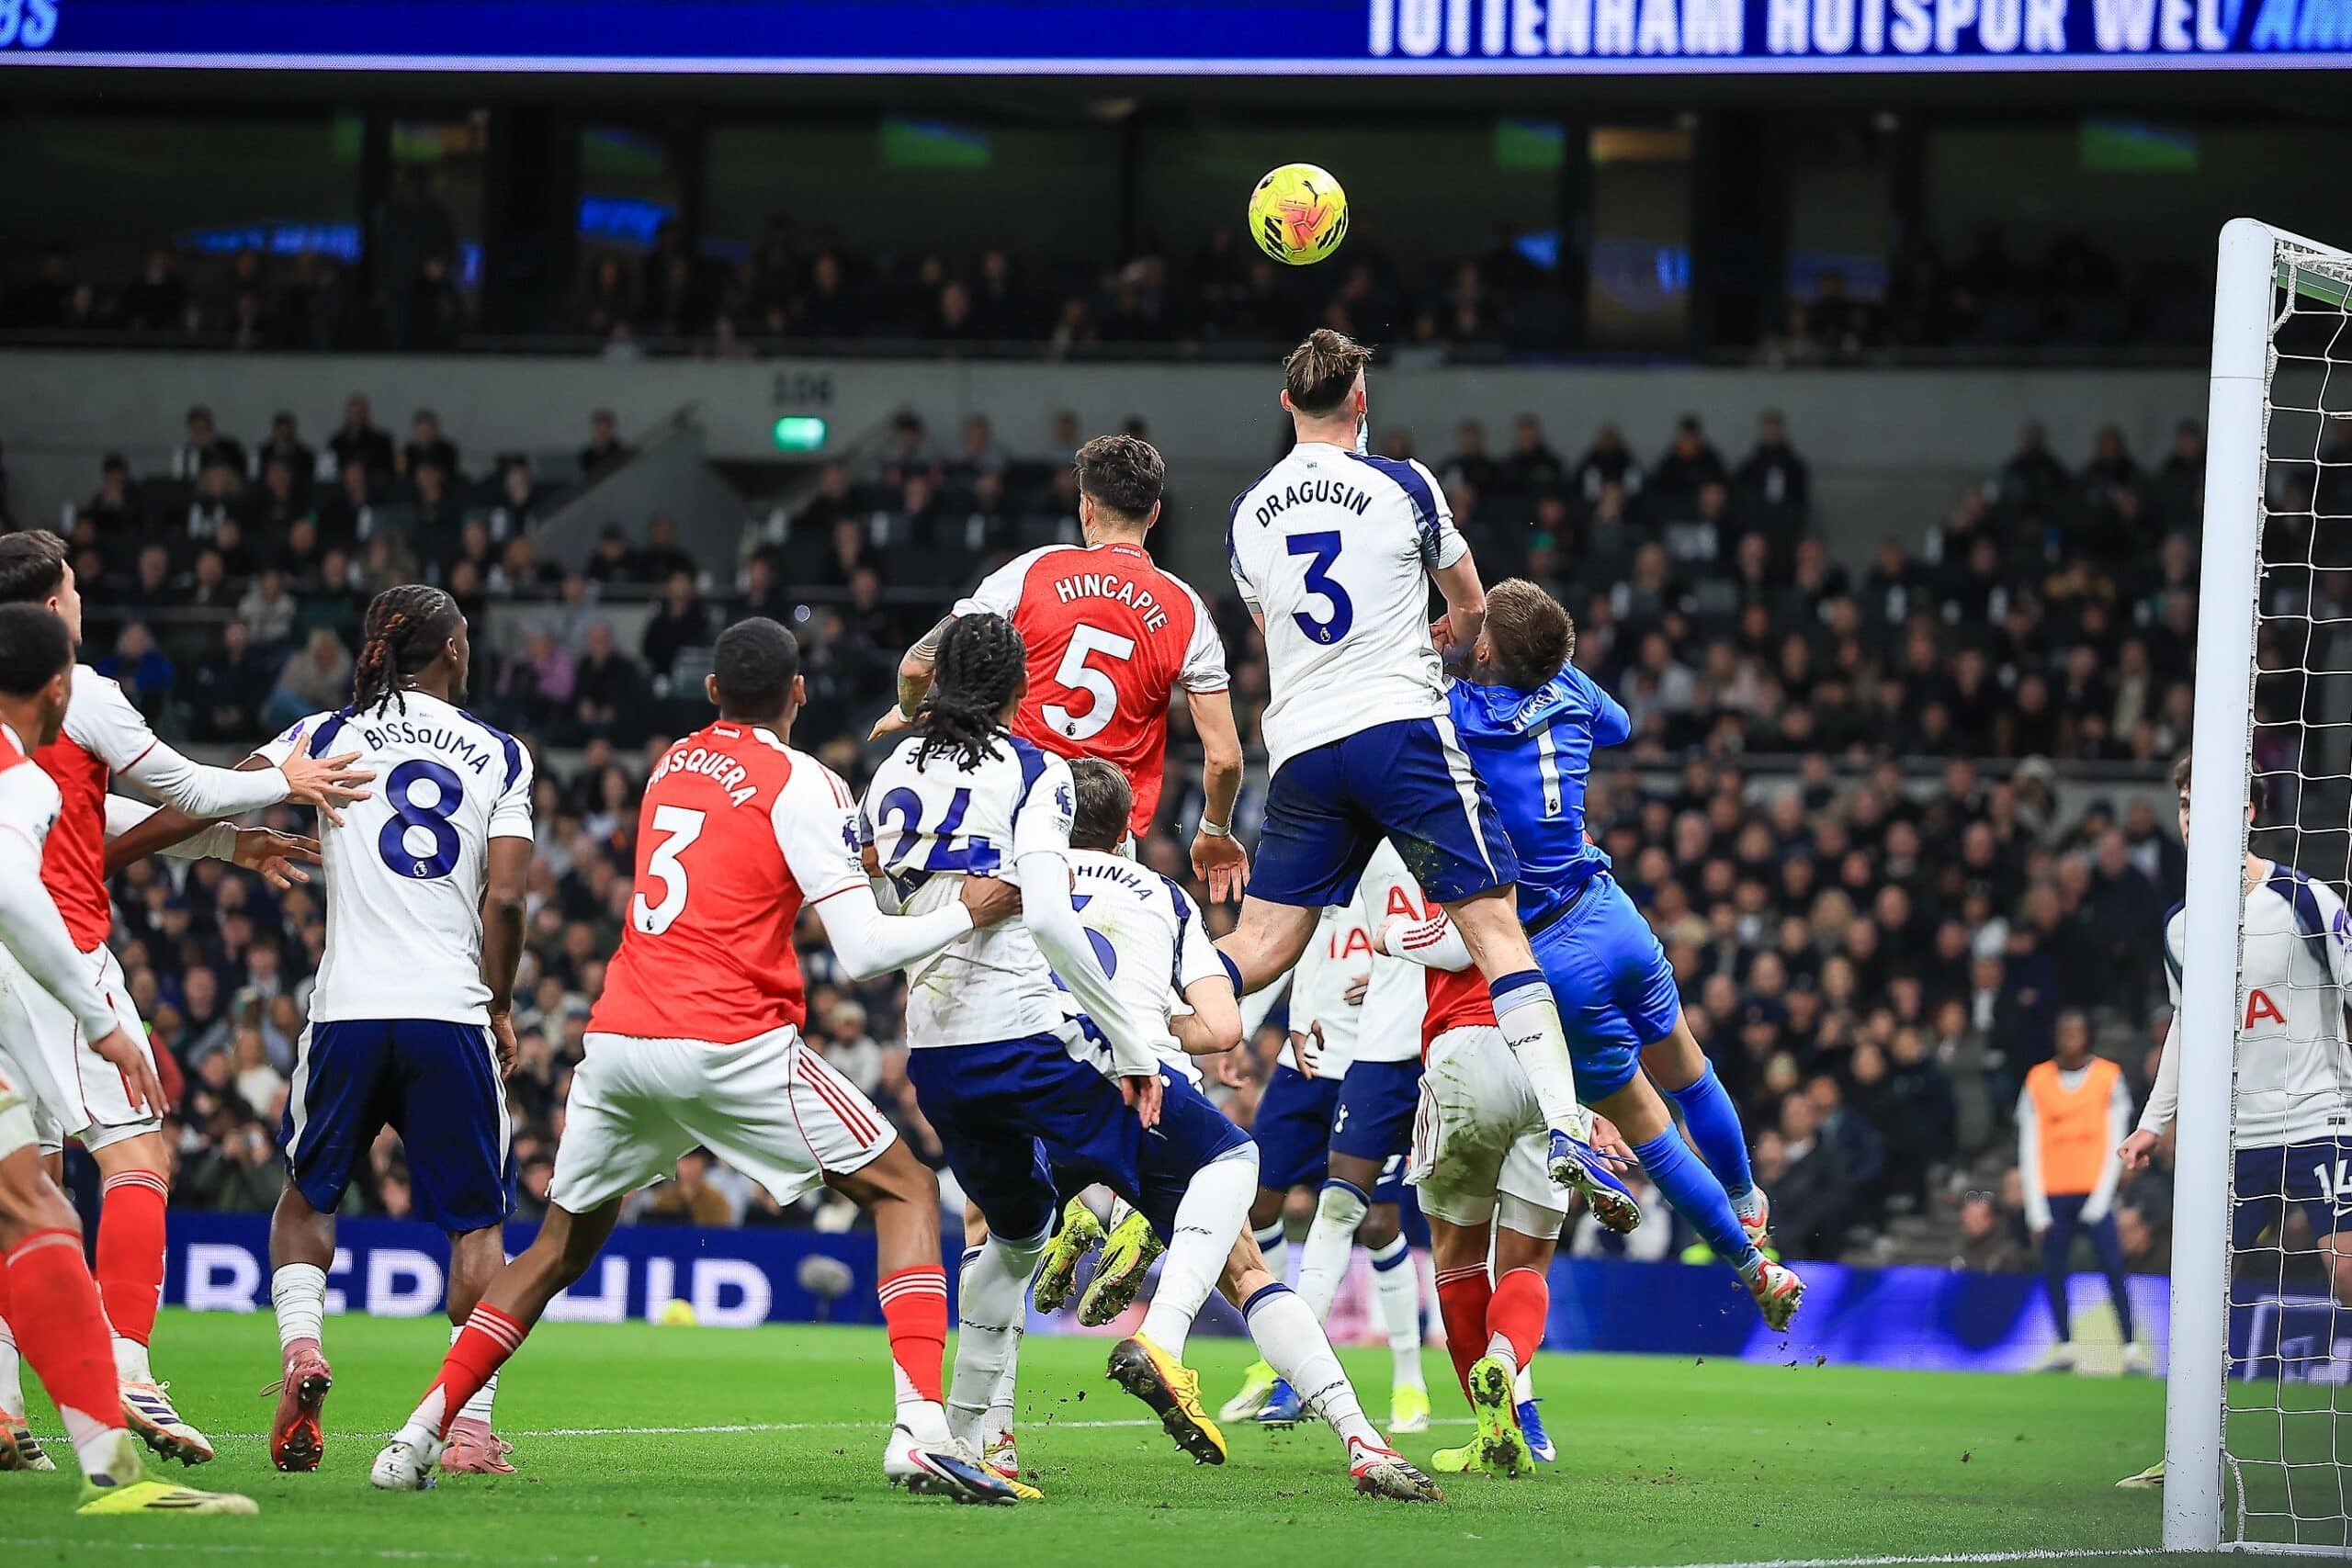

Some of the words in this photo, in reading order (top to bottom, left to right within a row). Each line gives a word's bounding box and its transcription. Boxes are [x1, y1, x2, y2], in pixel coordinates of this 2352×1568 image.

[1255, 480, 1373, 528] DRAGUSIN
[1054, 573, 1170, 633] HINCAPIE
[1286, 530, 1353, 645] 3
[1041, 622, 1136, 741] 5
[364, 722, 492, 775] BISSOUMA
[378, 759, 464, 879] 8
[878, 786, 1001, 875] 24
[632, 805, 707, 936] 3
[1078, 865, 1154, 901] HINHA
[2312, 1159, 2352, 1205] 14
